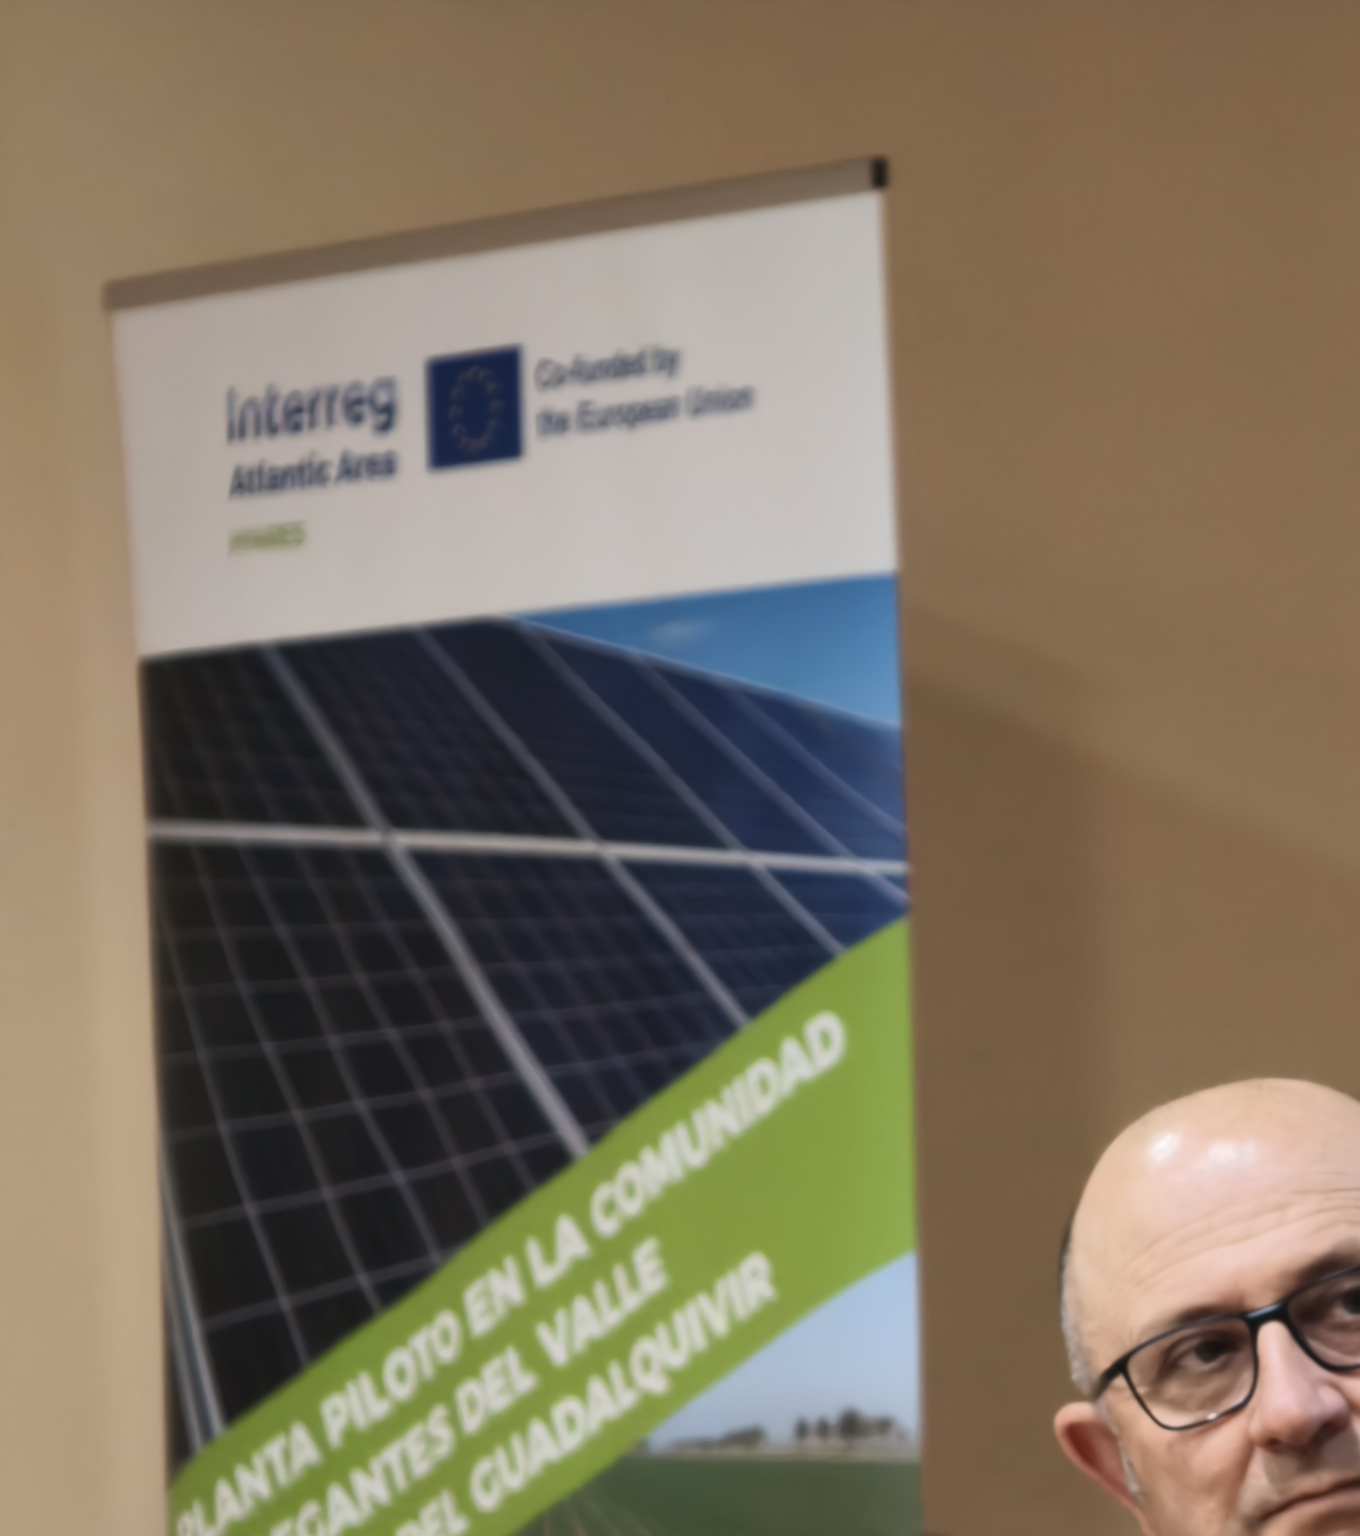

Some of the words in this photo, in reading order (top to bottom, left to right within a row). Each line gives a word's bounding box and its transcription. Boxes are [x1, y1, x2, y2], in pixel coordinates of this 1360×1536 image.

[227, 376, 397, 444] Interreg
[229, 449, 331, 496] Atlantic
[334, 449, 397, 484] Area
[321, 1309, 461, 1449] PILOTO
[463, 1256, 525, 1337] EN
[526, 1214, 590, 1289] LA
[590, 1011, 846, 1237] COMUNIDAD
[456, 1345, 537, 1435] DEL
[535, 1237, 667, 1367] VALLE
[469, 1252, 775, 1512] GUADALQUIVIR
